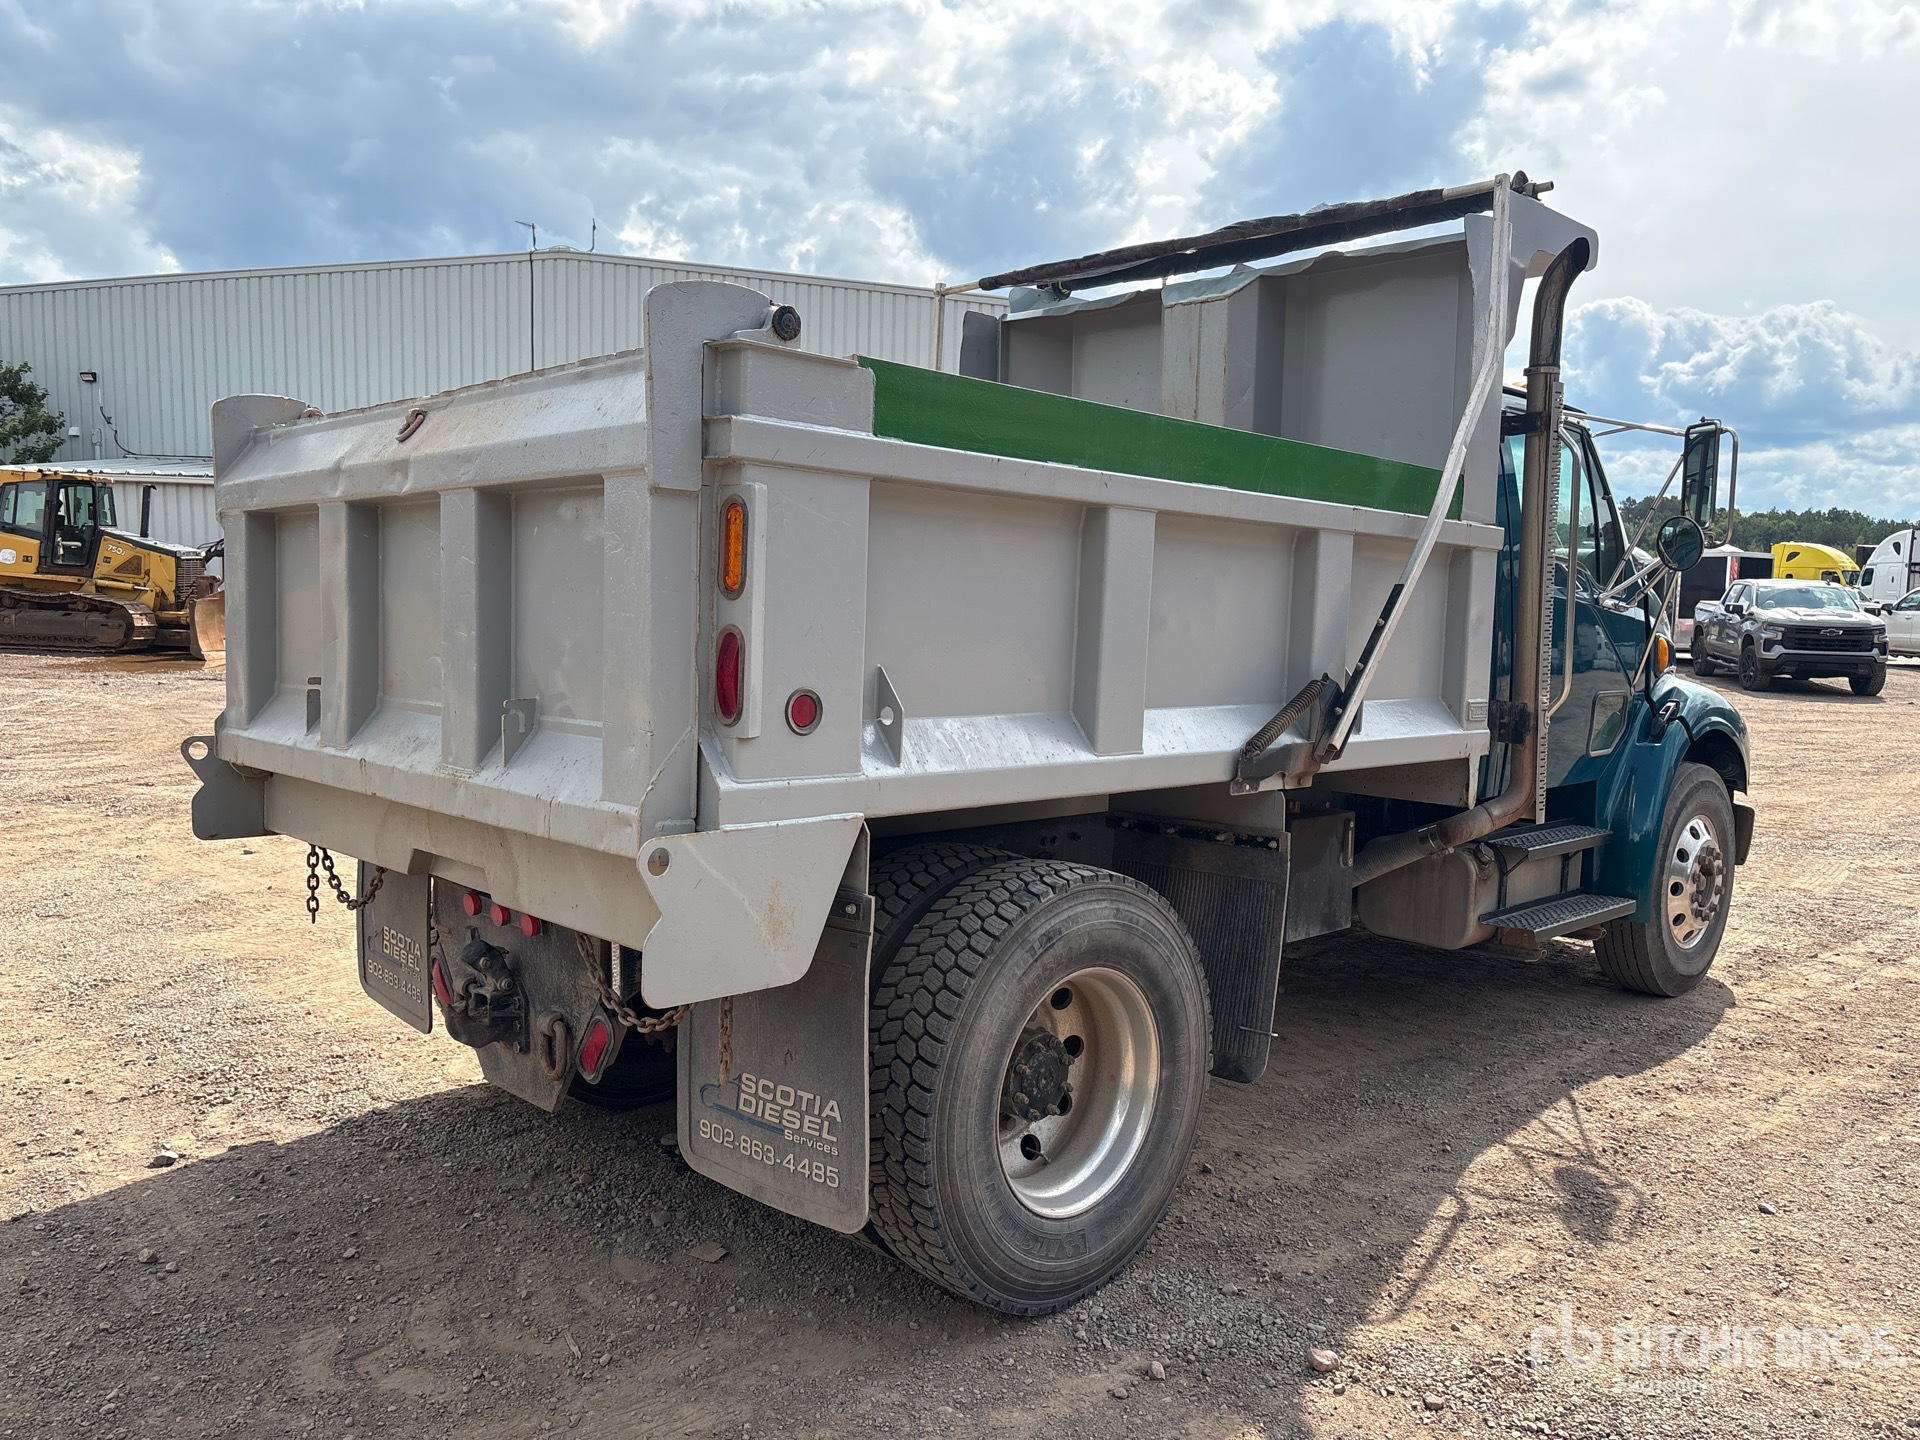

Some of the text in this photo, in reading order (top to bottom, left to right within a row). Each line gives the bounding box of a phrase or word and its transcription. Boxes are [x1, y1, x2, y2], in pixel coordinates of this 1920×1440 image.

[383, 925, 422, 959] SCOTIA
[383, 940, 420, 972] DIESEL
[367, 959, 422, 1003] 902-863-4485
[739, 1092, 839, 1143] DIESEL
[741, 1072, 842, 1123] SCOTIA
[699, 1118, 840, 1189] 902-863-4485
[784, 1129, 839, 1156] Services
